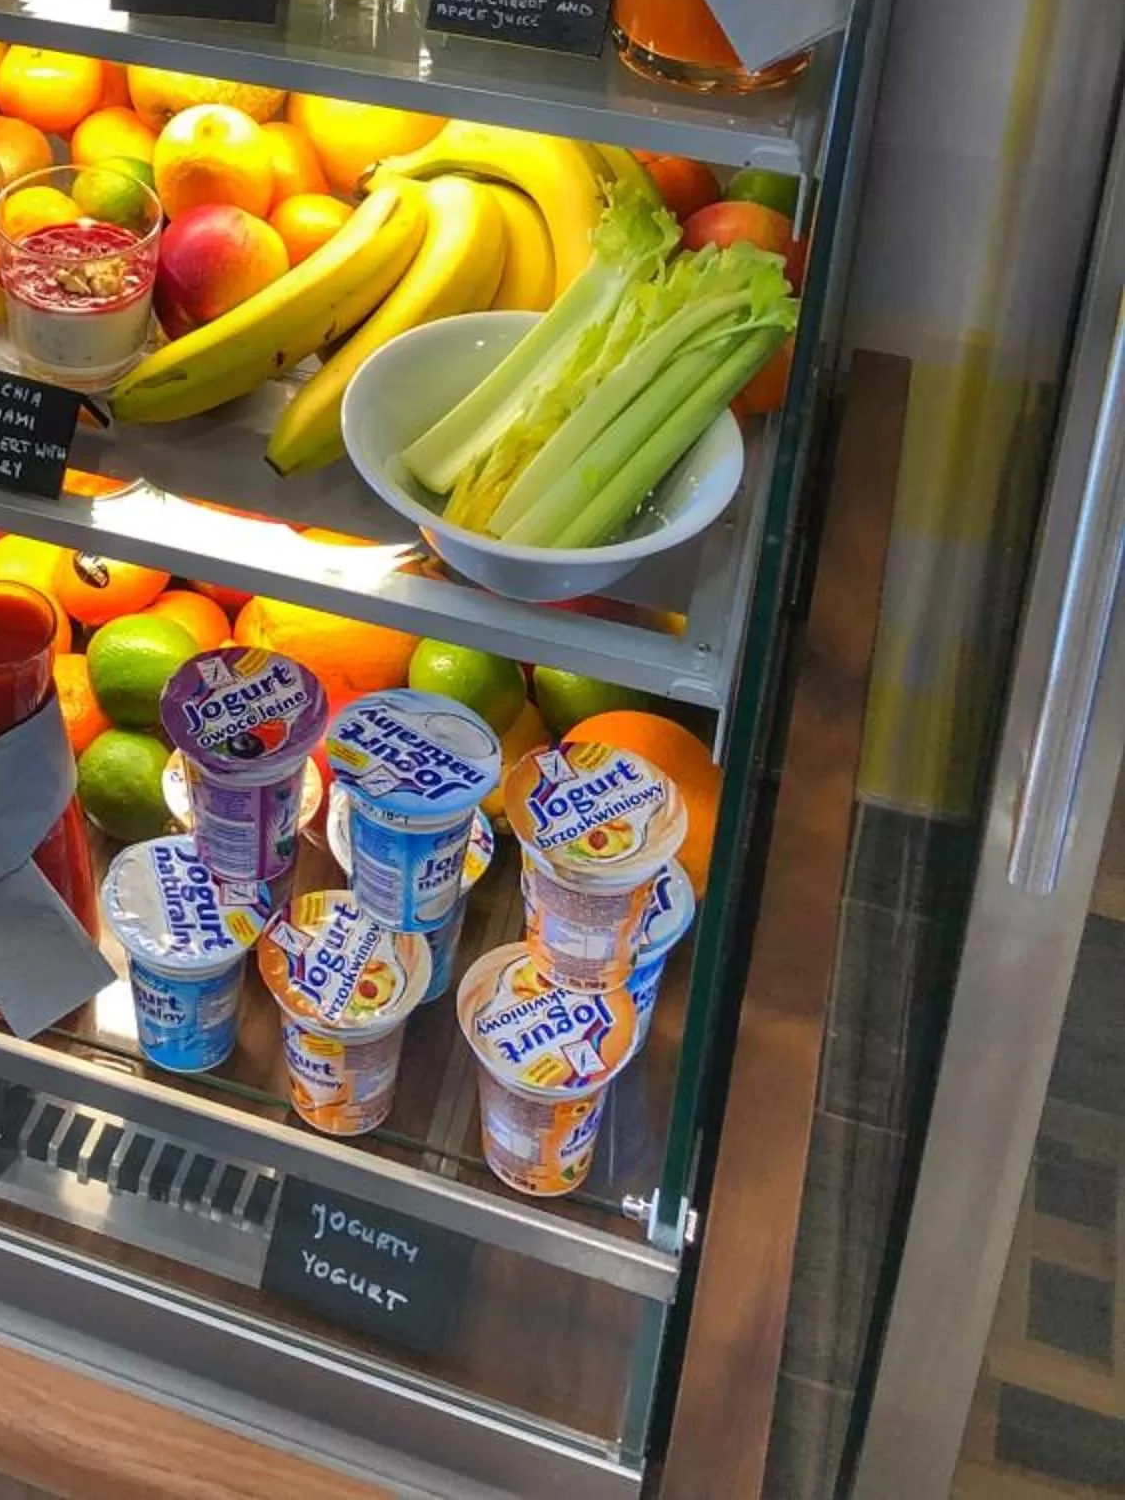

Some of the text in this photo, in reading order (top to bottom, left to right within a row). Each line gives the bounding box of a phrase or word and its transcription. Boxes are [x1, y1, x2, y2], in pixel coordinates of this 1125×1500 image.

[436, 2, 540, 29] APPLE JUICE
[555, 1, 595, 18] AND
[34, 442, 67, 461] WITH
[183, 662, 293, 734] Jogurt
[338, 721, 473, 801] Jogurt
[357, 706, 488, 785] naturalny
[527, 758, 641, 833] Jogurt
[535, 780, 665, 849] brzoskwiniowy
[154, 846, 198, 956] naturalny
[174, 845, 234, 952] Jogurt
[290, 901, 361, 1005] Jogurt
[476, 987, 573, 1036] skwiniowy
[497, 994, 615, 1064] Jogurt
[310, 1202, 421, 1264] JOGURTY
[301, 1249, 410, 1312] YOGURT
